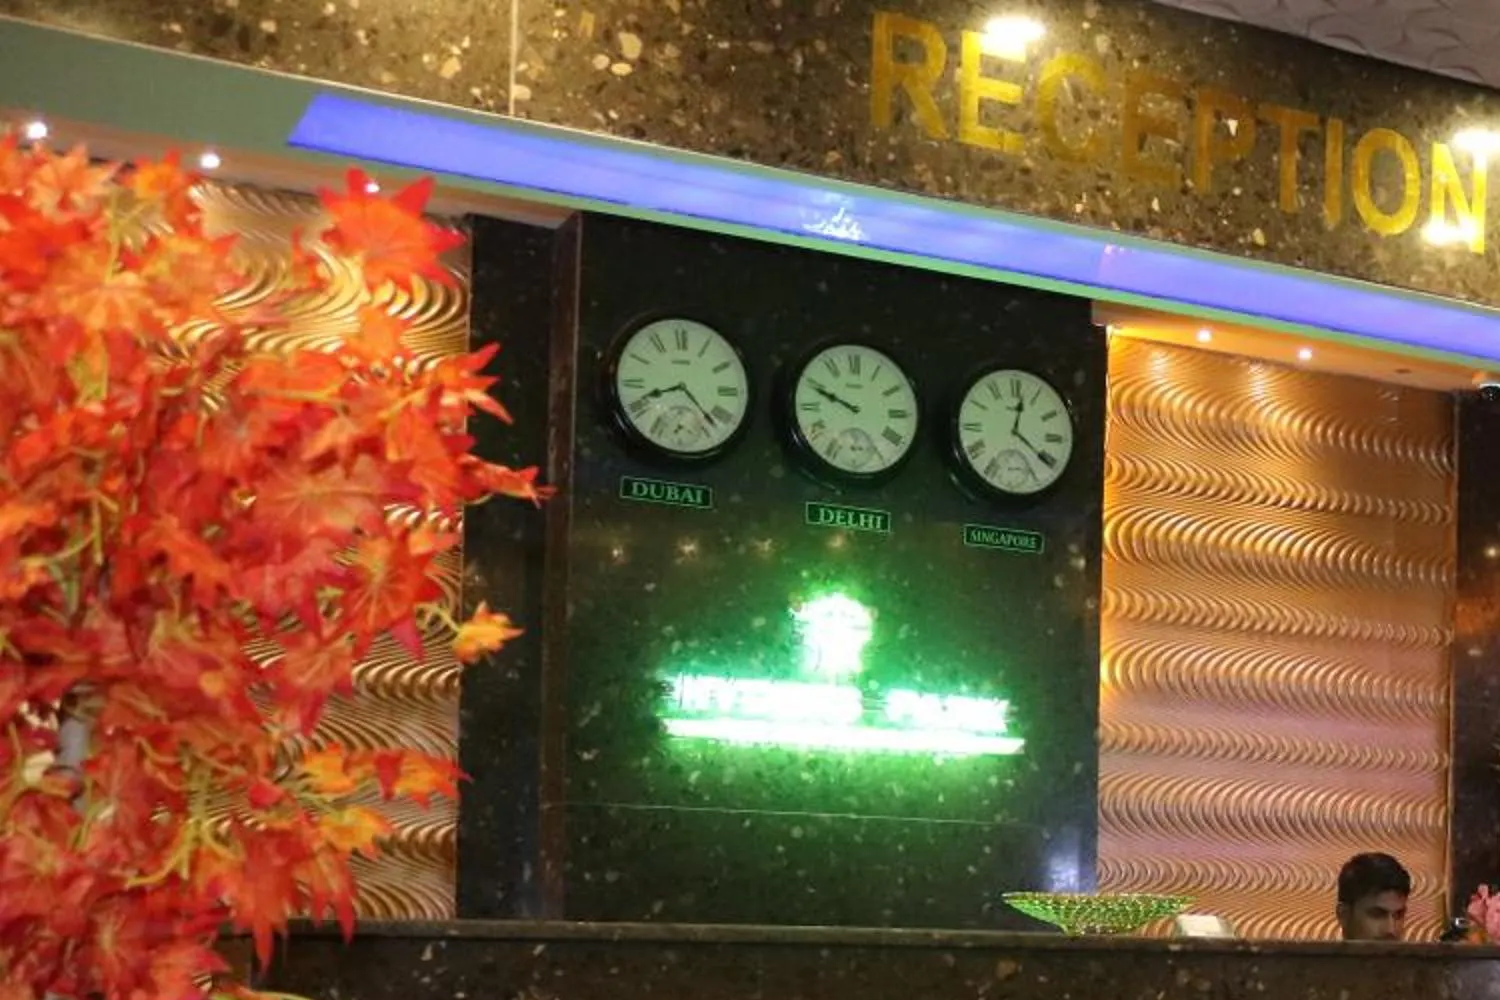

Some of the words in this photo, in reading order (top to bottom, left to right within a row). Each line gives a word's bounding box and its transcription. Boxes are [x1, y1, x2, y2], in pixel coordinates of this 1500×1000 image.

[871, 11, 1488, 256] RECEPTION
[632, 481, 704, 504] DUBAI
[818, 507, 884, 530] DELHI
[969, 529, 1037, 549] SINGAPORE
